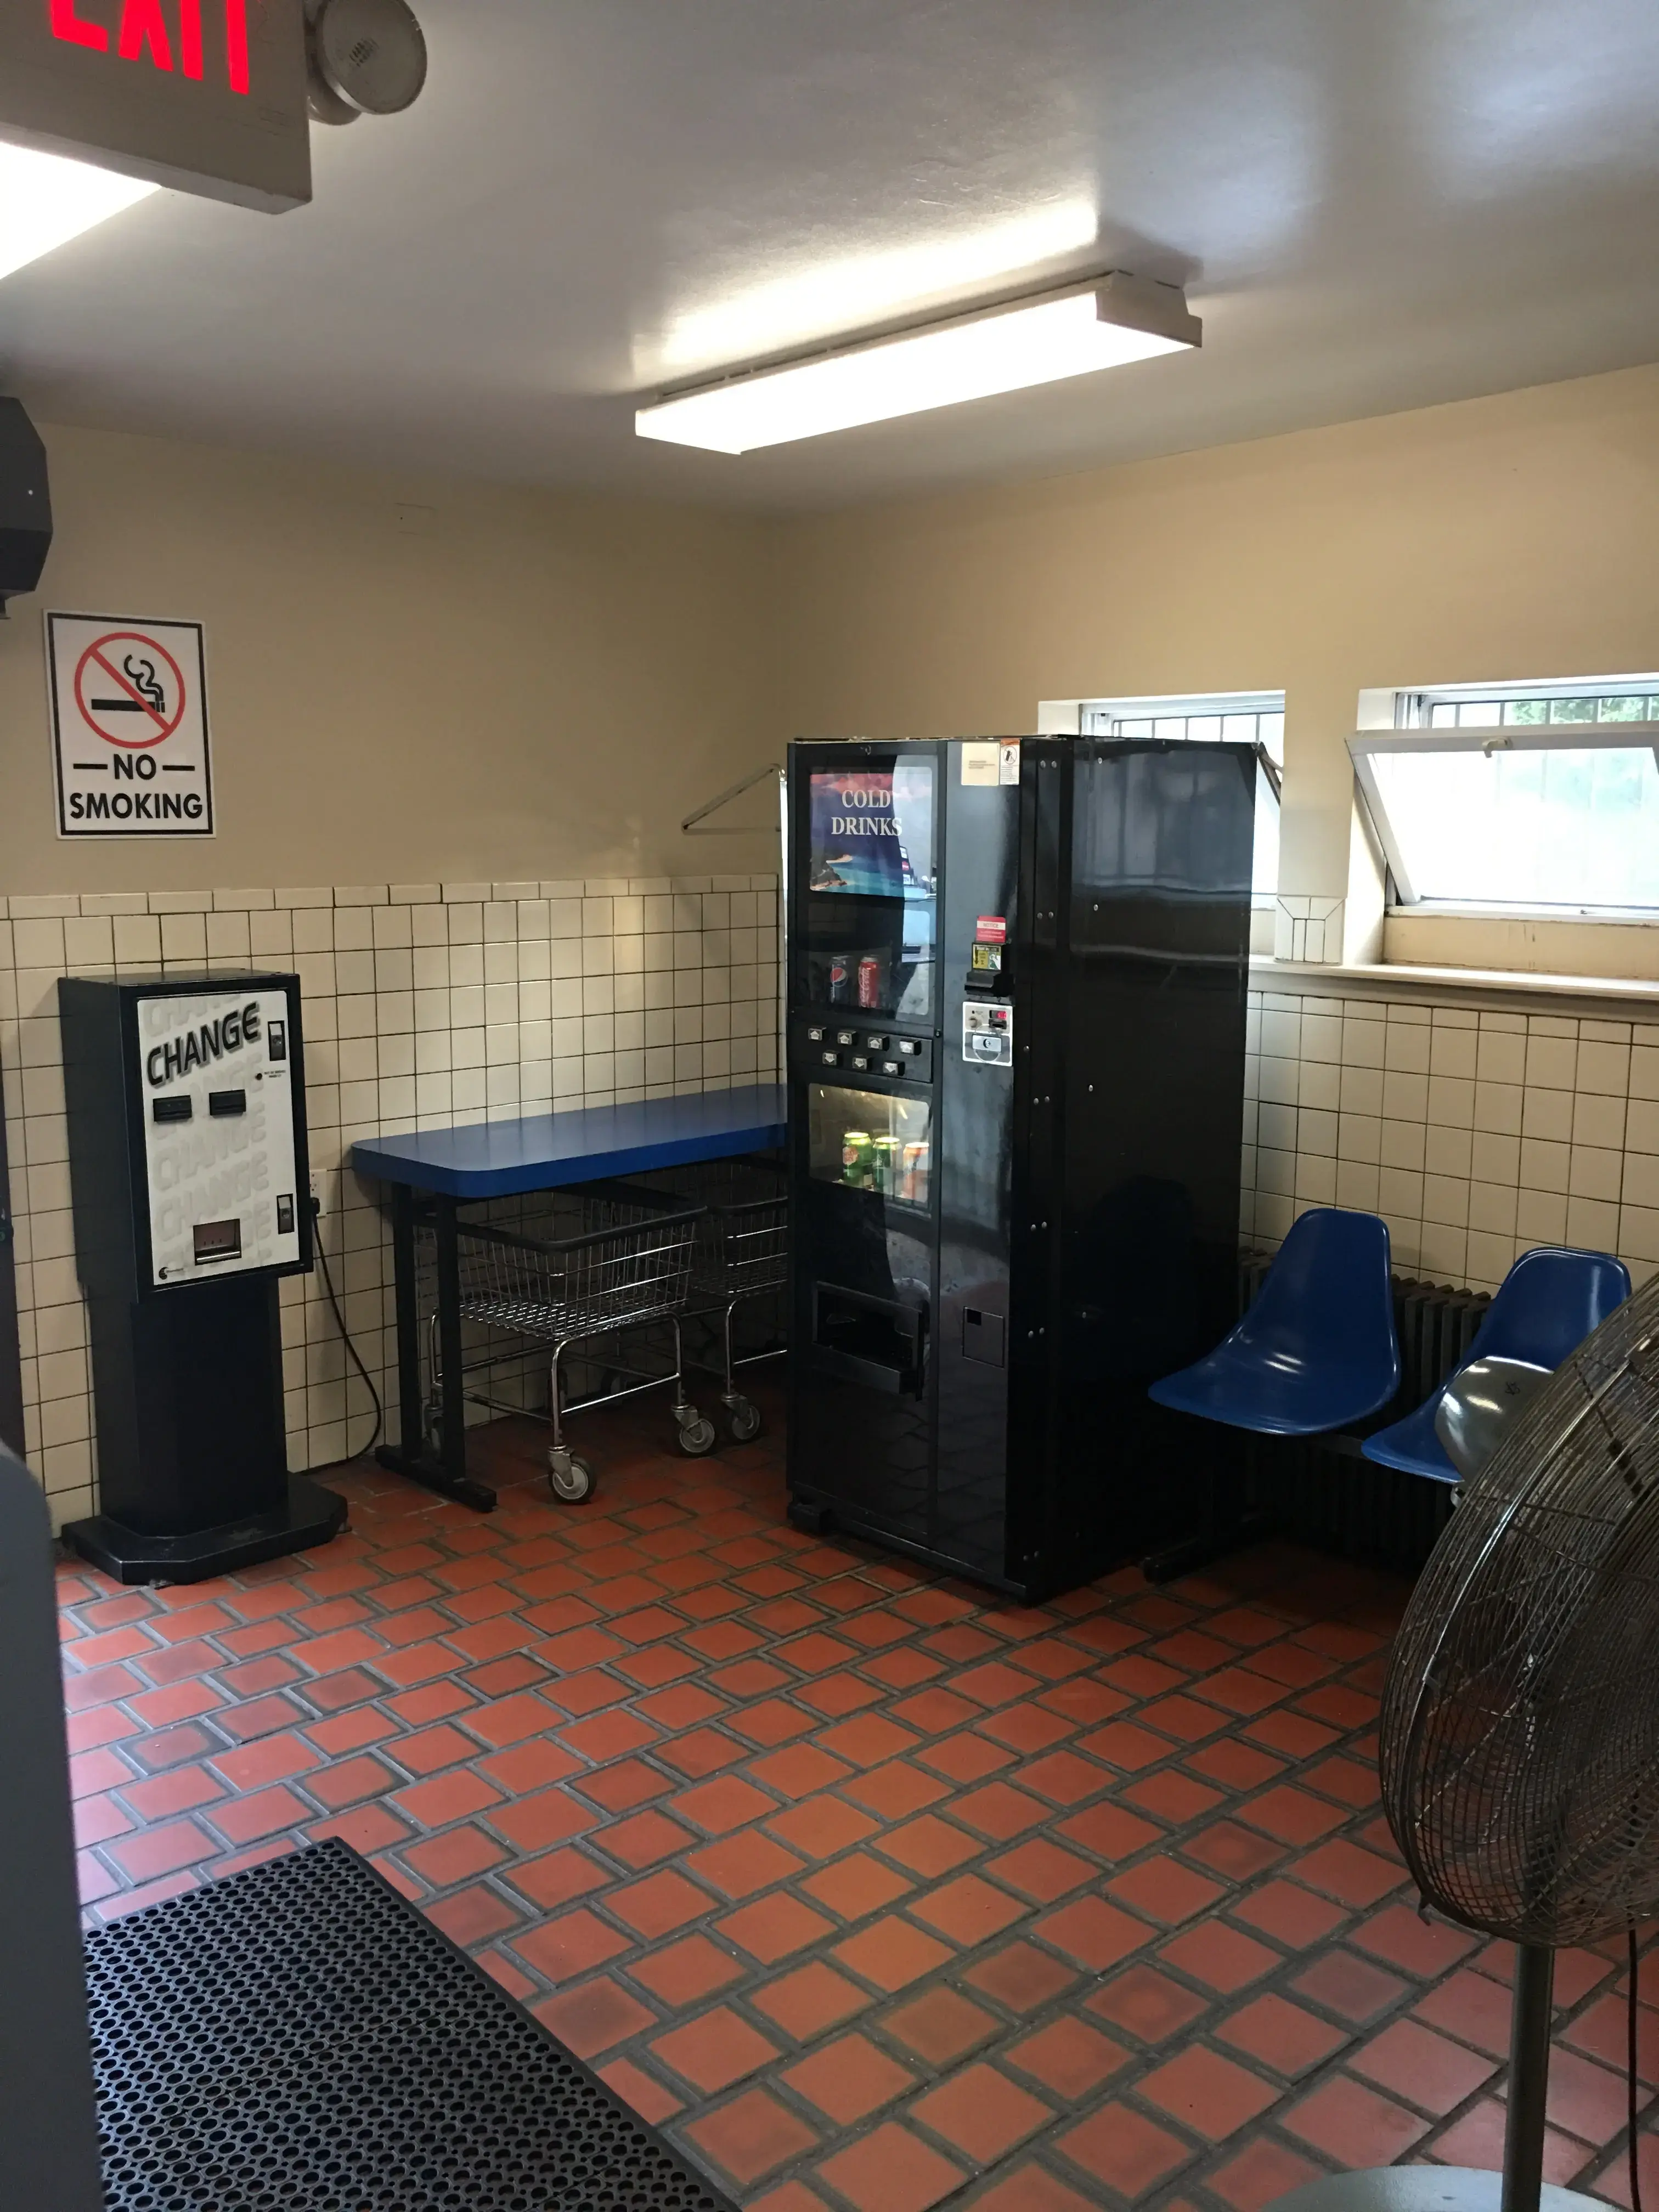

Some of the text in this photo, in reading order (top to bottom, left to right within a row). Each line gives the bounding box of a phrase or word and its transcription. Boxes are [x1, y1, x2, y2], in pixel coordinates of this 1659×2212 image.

[114, 754, 157, 780] NO
[70, 792, 203, 819] SMOKING
[842, 789, 890, 808] COLD
[831, 816, 902, 836] DRINKS
[146, 1001, 261, 1089] CHANGE
